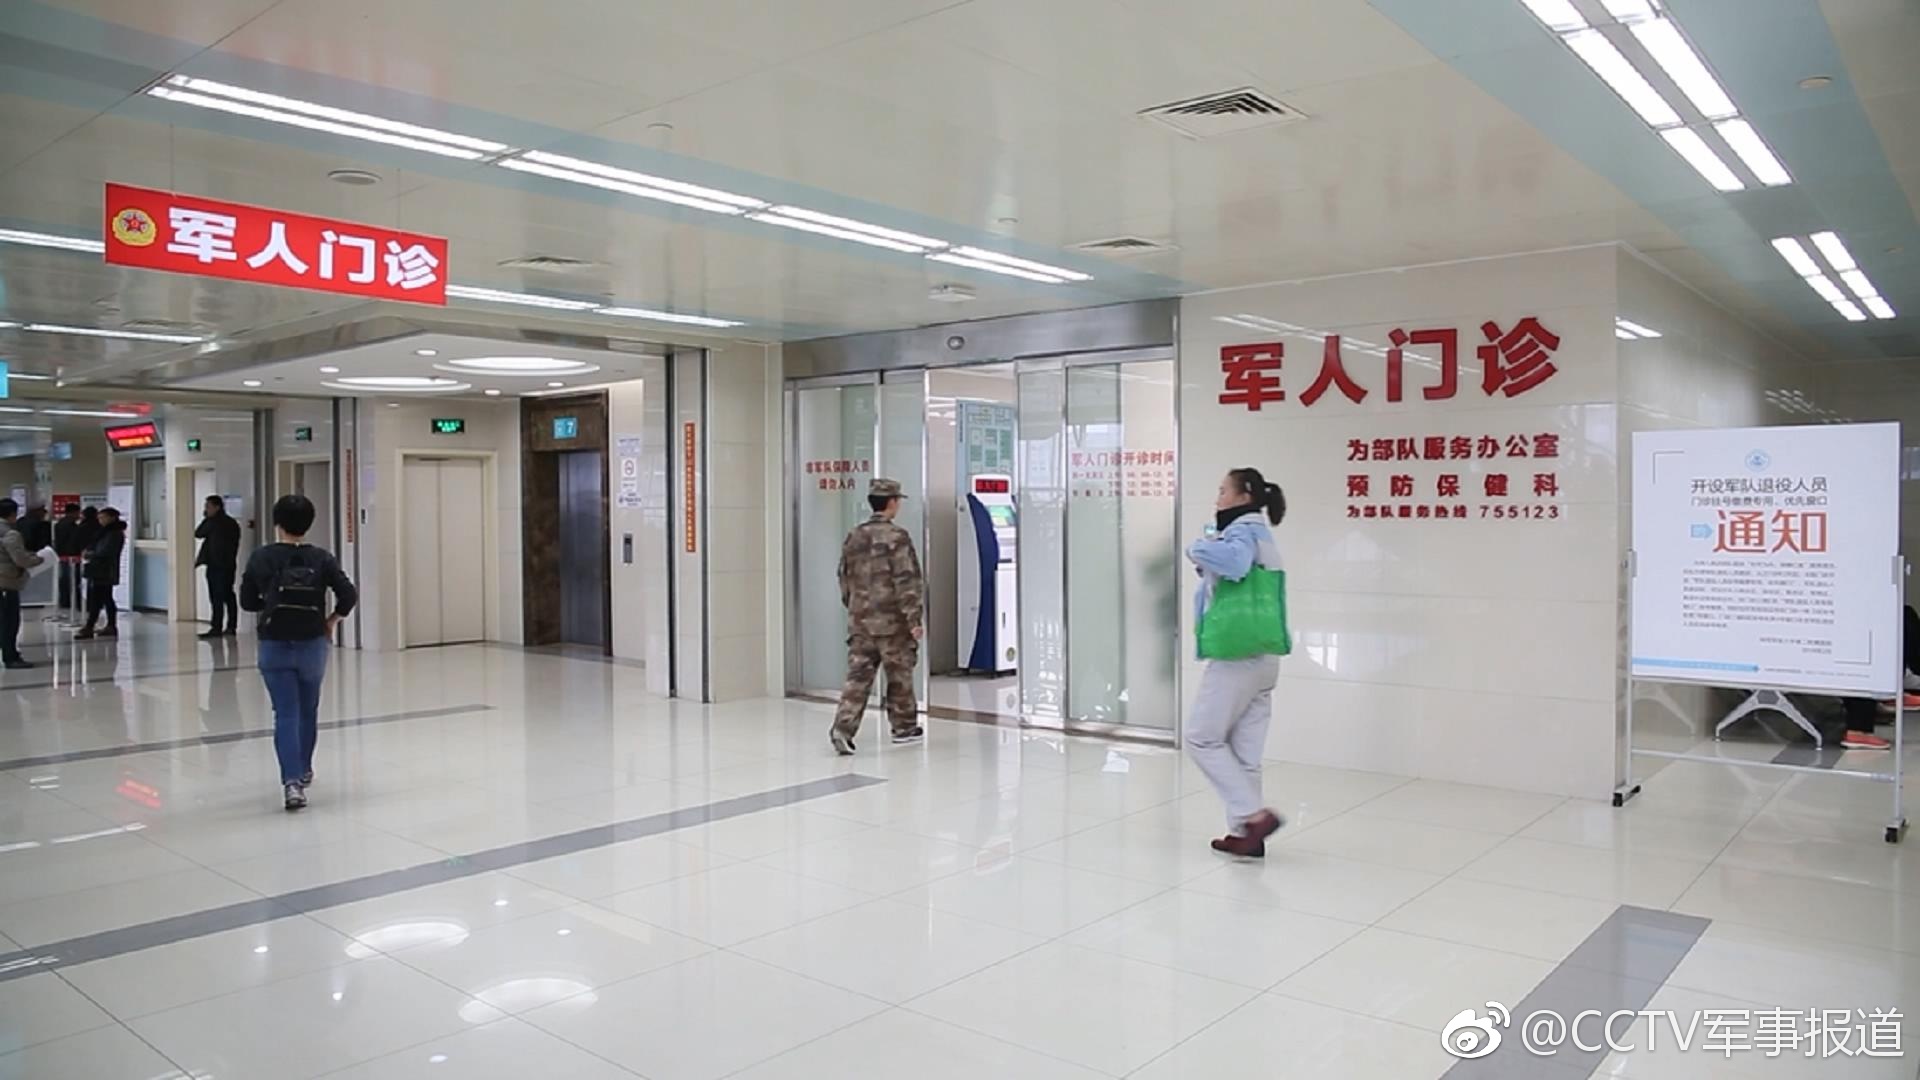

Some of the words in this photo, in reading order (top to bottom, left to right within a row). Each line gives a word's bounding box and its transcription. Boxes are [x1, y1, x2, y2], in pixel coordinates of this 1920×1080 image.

[167, 207, 439, 290] 军人门诊
[1218, 317, 1560, 411] 军人门诊
[1347, 434, 1559, 462] 为部队服务办公室
[1347, 474, 1559, 497] 预防保健科
[1690, 476, 1828, 494] 开设军队退役人员
[1347, 504, 1468, 520] 为部队服务热线
[1479, 504, 1559, 519] 755123
[1713, 509, 1827, 554] 通知
